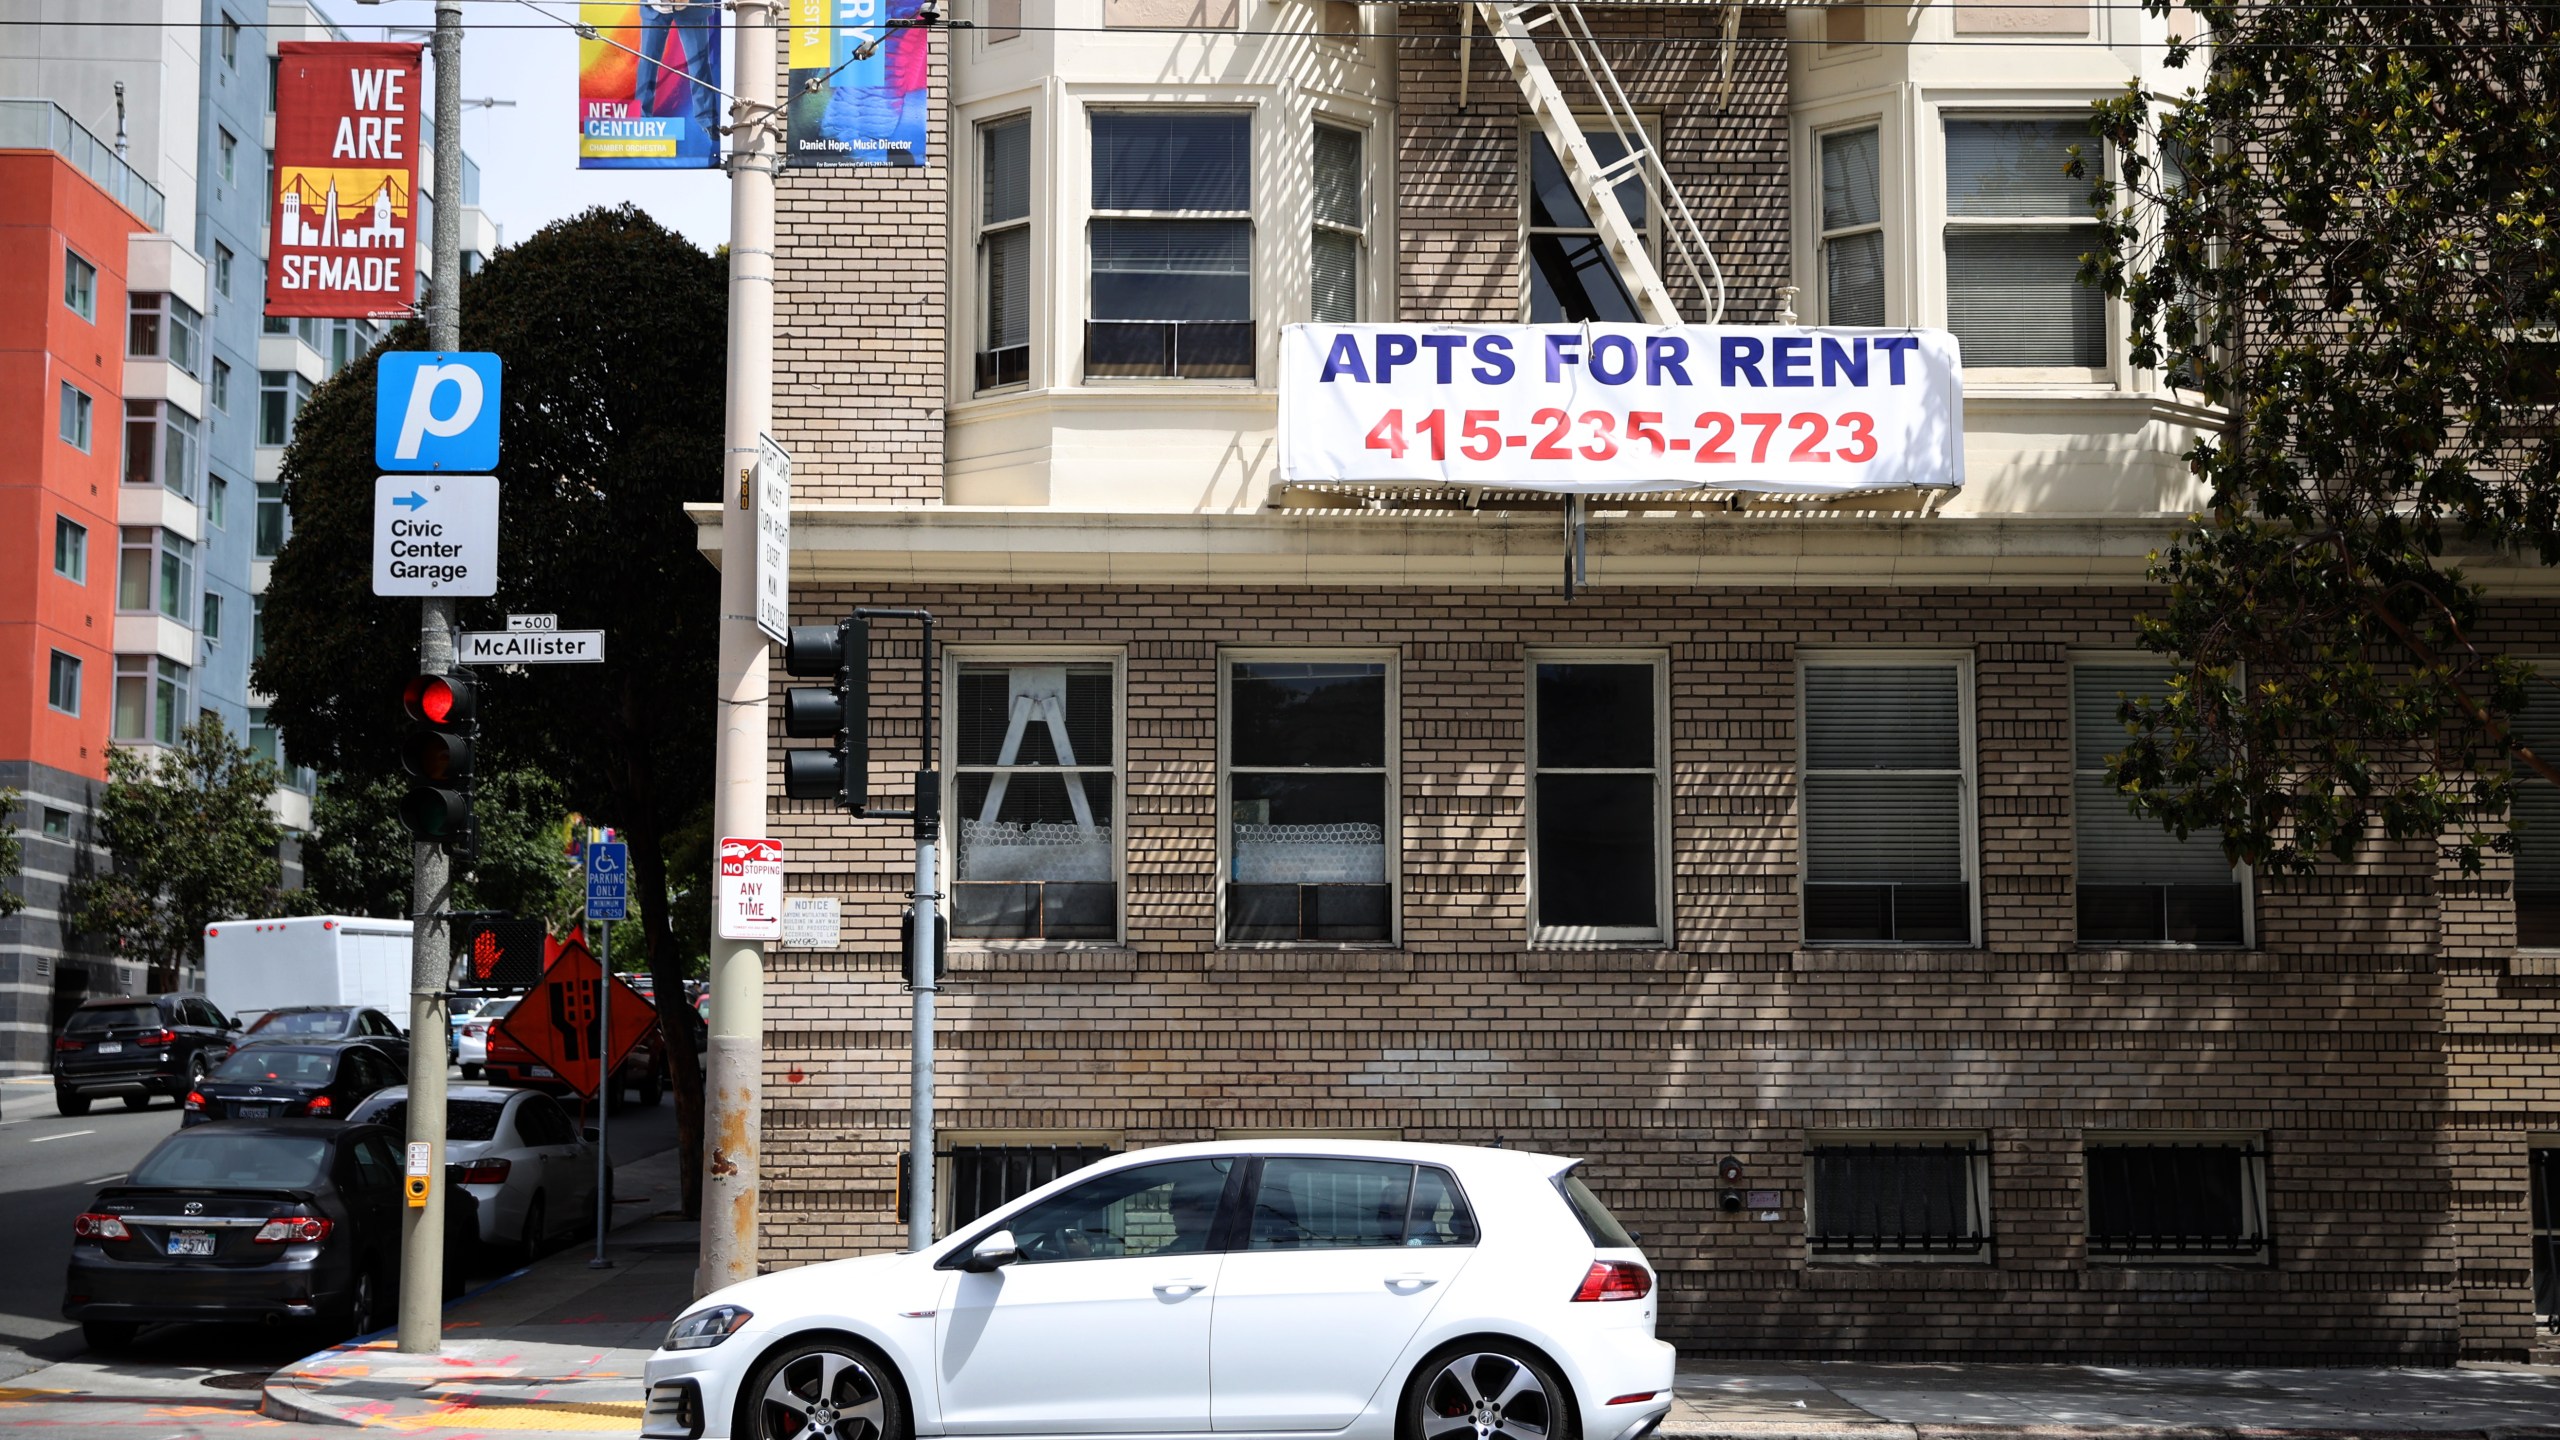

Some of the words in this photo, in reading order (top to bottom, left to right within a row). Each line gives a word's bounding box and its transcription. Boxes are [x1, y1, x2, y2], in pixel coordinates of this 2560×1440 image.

[351, 68, 406, 111] WE
[589, 102, 628, 119] NEW
[589, 120, 667, 137] CENTURY
[332, 116, 404, 160] ARE
[799, 139, 827, 150] Daniel
[828, 139, 852, 152] Hope,
[853, 139, 877, 150] Music
[878, 139, 912, 150] Director
[589, 144, 624, 152] CHAMBER
[625, 144, 668, 152] ORCHESTRA
[281, 255, 401, 292] SFMADE
[1319, 333, 1516, 385] APTS
[1545, 334, 1693, 386] FOR
[1720, 336, 1919, 387] RENT
[1365, 407, 1879, 463] 415-235-2723
[741, 469, 749, 509] 580
[767, 481, 782, 510] MUST
[391, 519, 443, 537] Civic
[390, 540, 463, 558] Center
[390, 560, 467, 583] Garage
[524, 617, 552, 629] 600
[474, 637, 587, 656] McAllister
[723, 862, 743, 875] NO
[744, 864, 780, 875] STOPPING
[589, 873, 624, 884] PARKING
[596, 885, 617, 896] ONLY
[740, 882, 763, 896] ANY
[589, 908, 603, 917] FINE
[593, 900, 619, 908] MINIMUM
[738, 902, 765, 916] TIME
[795, 900, 829, 910] NOTICE
